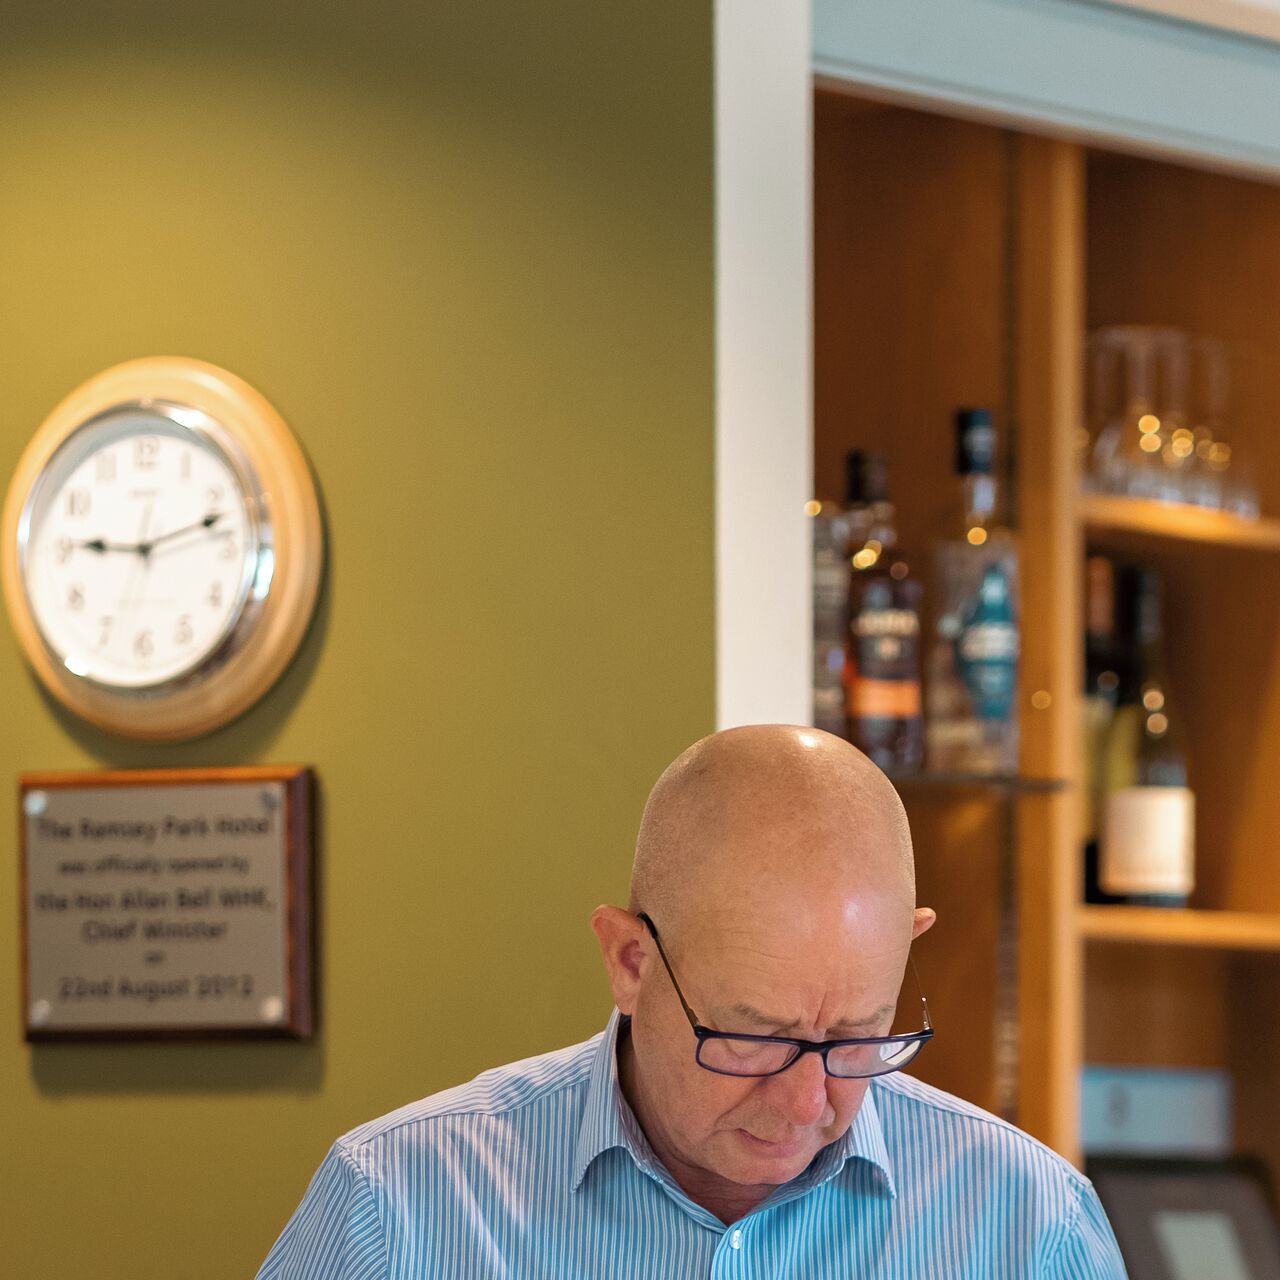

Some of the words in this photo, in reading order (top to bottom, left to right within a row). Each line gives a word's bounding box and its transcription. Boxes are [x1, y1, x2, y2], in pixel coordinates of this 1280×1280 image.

[134, 437, 161, 469] 12
[134, 629, 154, 659] 6
[35, 816, 75, 840] The
[79, 818, 158, 845] Ramsey
[163, 817, 210, 839] Park
[216, 816, 273, 838] Hotel
[58, 860, 89, 876] was
[91, 857, 162, 878] officially
[166, 857, 226, 876] opened
[228, 854, 251, 876] by
[35, 891, 70, 912] the
[74, 891, 115, 912] Hon
[176, 887, 213, 910] Bell
[82, 920, 137, 943] Chief
[142, 921, 229, 943] Minister
[59, 977, 113, 1001] 22nd
[118, 975, 191, 1005] August
[196, 974, 254, 999] 2012
